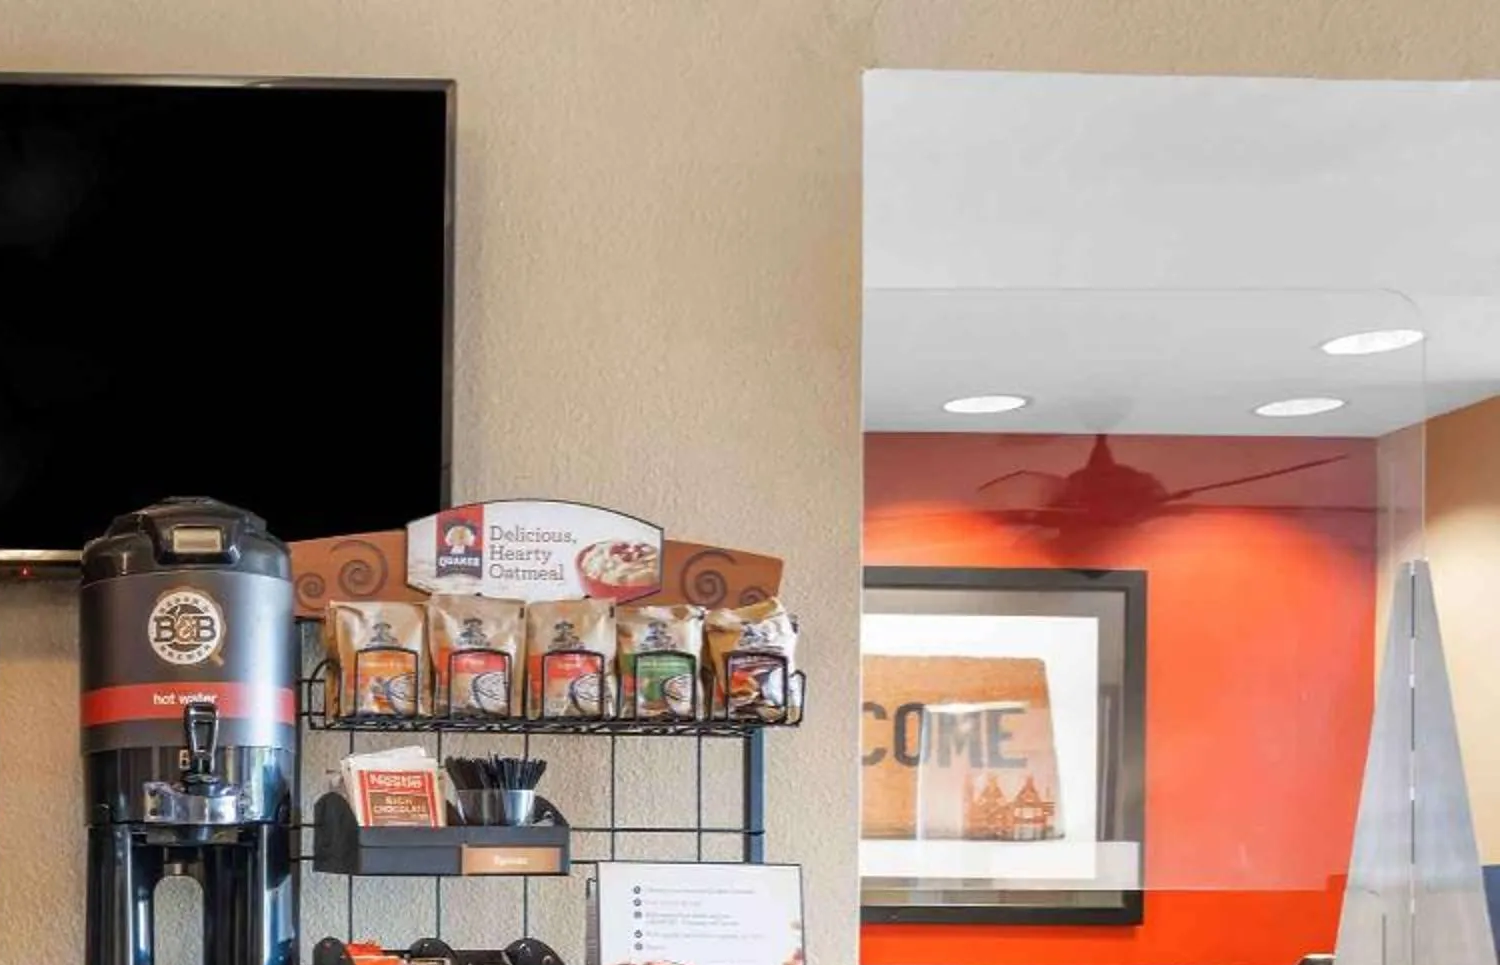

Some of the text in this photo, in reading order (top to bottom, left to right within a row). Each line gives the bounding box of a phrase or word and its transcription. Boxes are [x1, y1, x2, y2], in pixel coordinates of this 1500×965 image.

[489, 524, 577, 544] Delicious,
[439, 556, 480, 568] QUAKER
[489, 544, 553, 564] Hearty
[489, 563, 565, 581] Oatmeal
[153, 614, 217, 643] B&B
[153, 690, 218, 706] hot water
